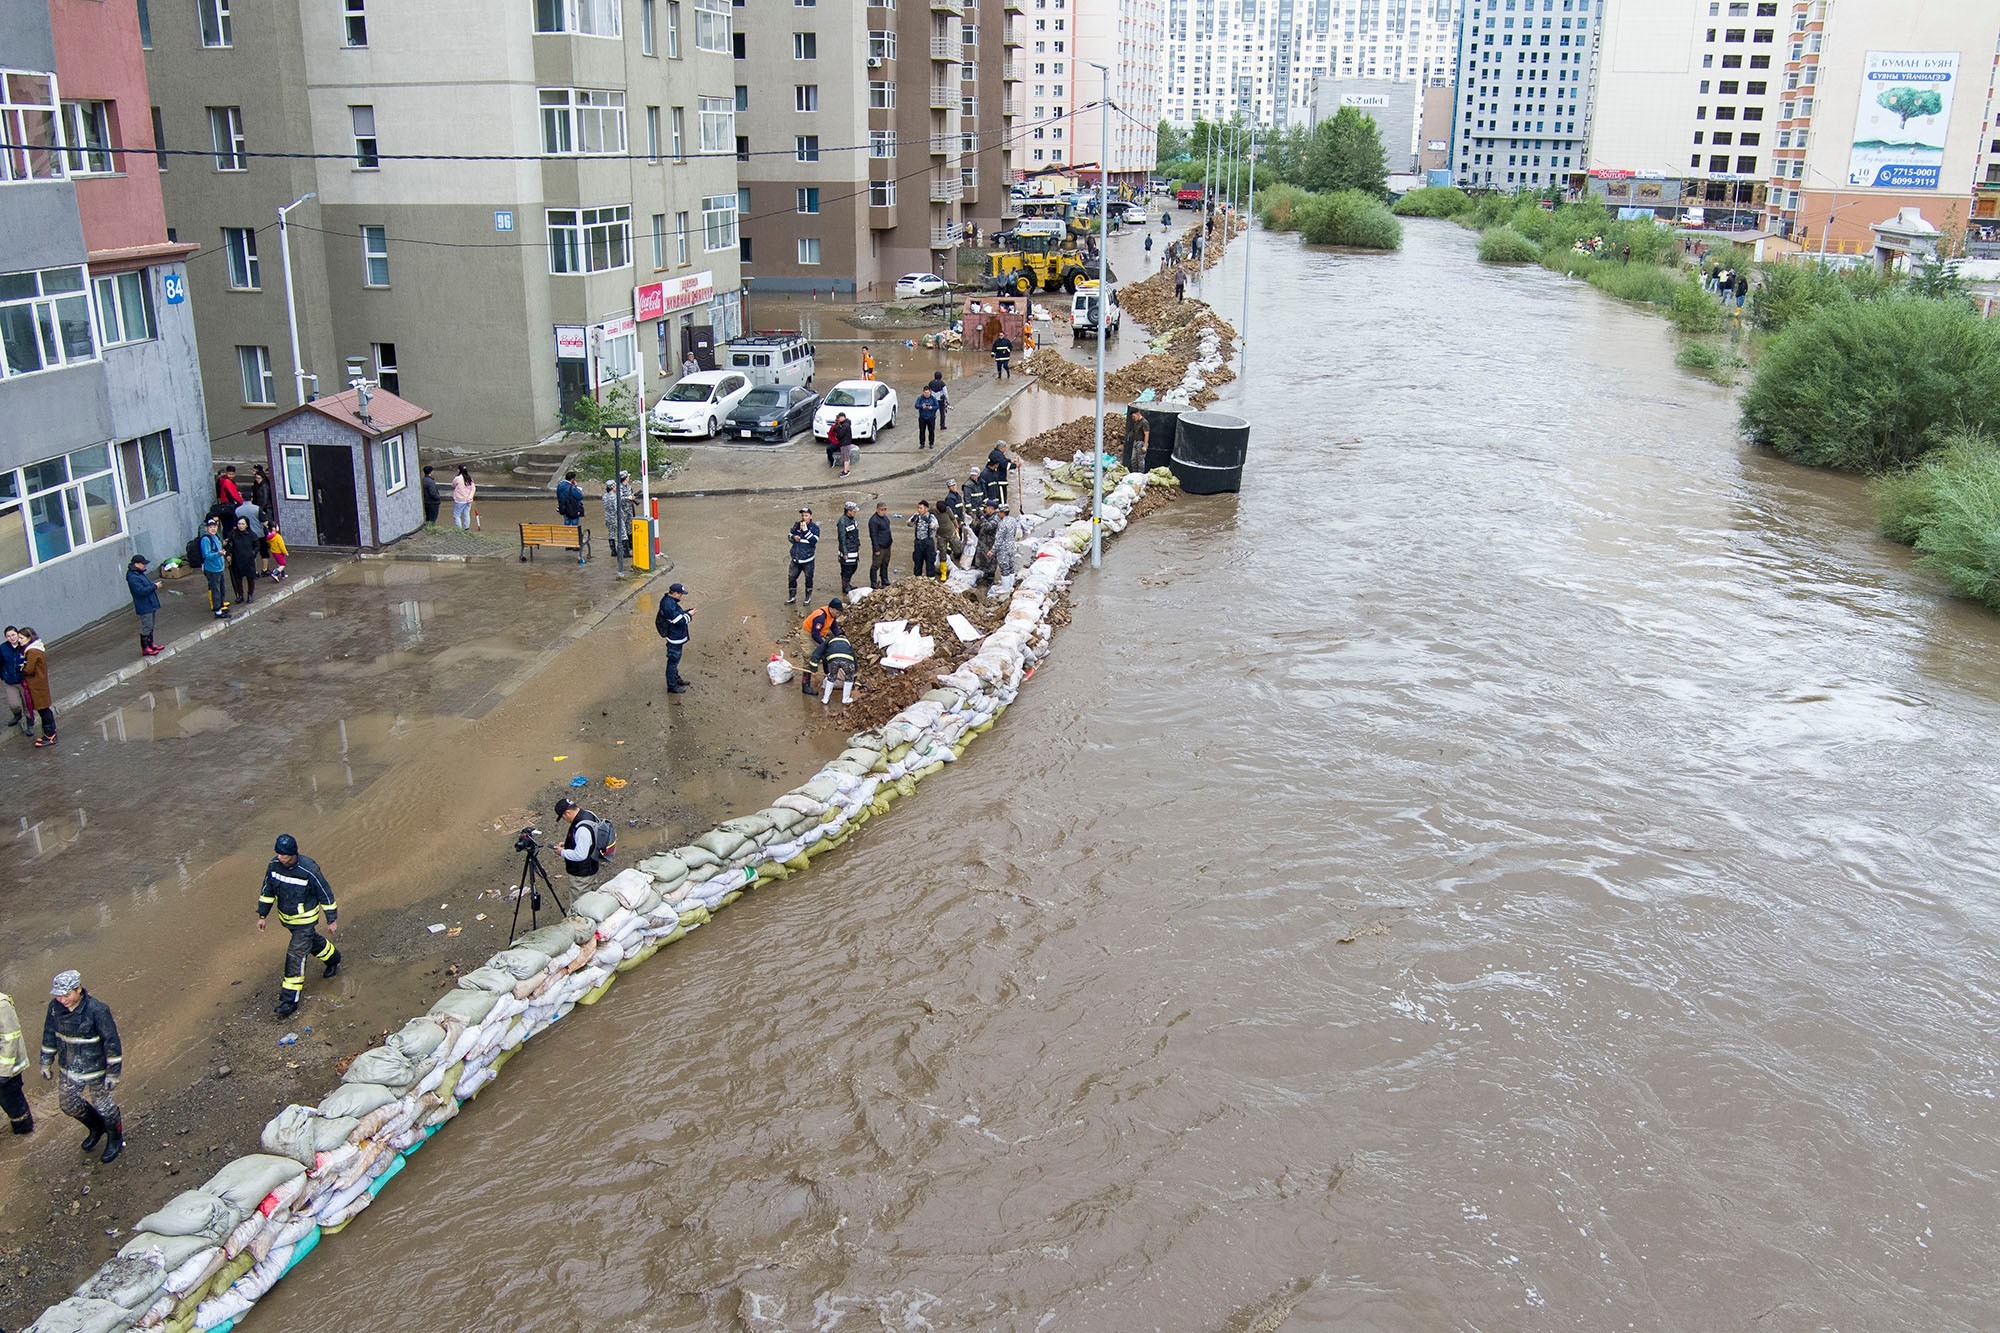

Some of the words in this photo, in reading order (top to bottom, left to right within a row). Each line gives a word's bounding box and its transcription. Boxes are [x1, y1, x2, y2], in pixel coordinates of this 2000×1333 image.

[1881, 59, 1919, 68] БУМАН
[1924, 59, 1953, 68] БУЯН
[1872, 72, 1899, 80] БУЯНЫ
[1859, 168, 1870, 176] 10
[1893, 168, 1936, 177] 7715-0001
[1891, 177, 1936, 186] 8099-9119
[497, 214, 511, 229] 96
[166, 278, 184, 299] 84
